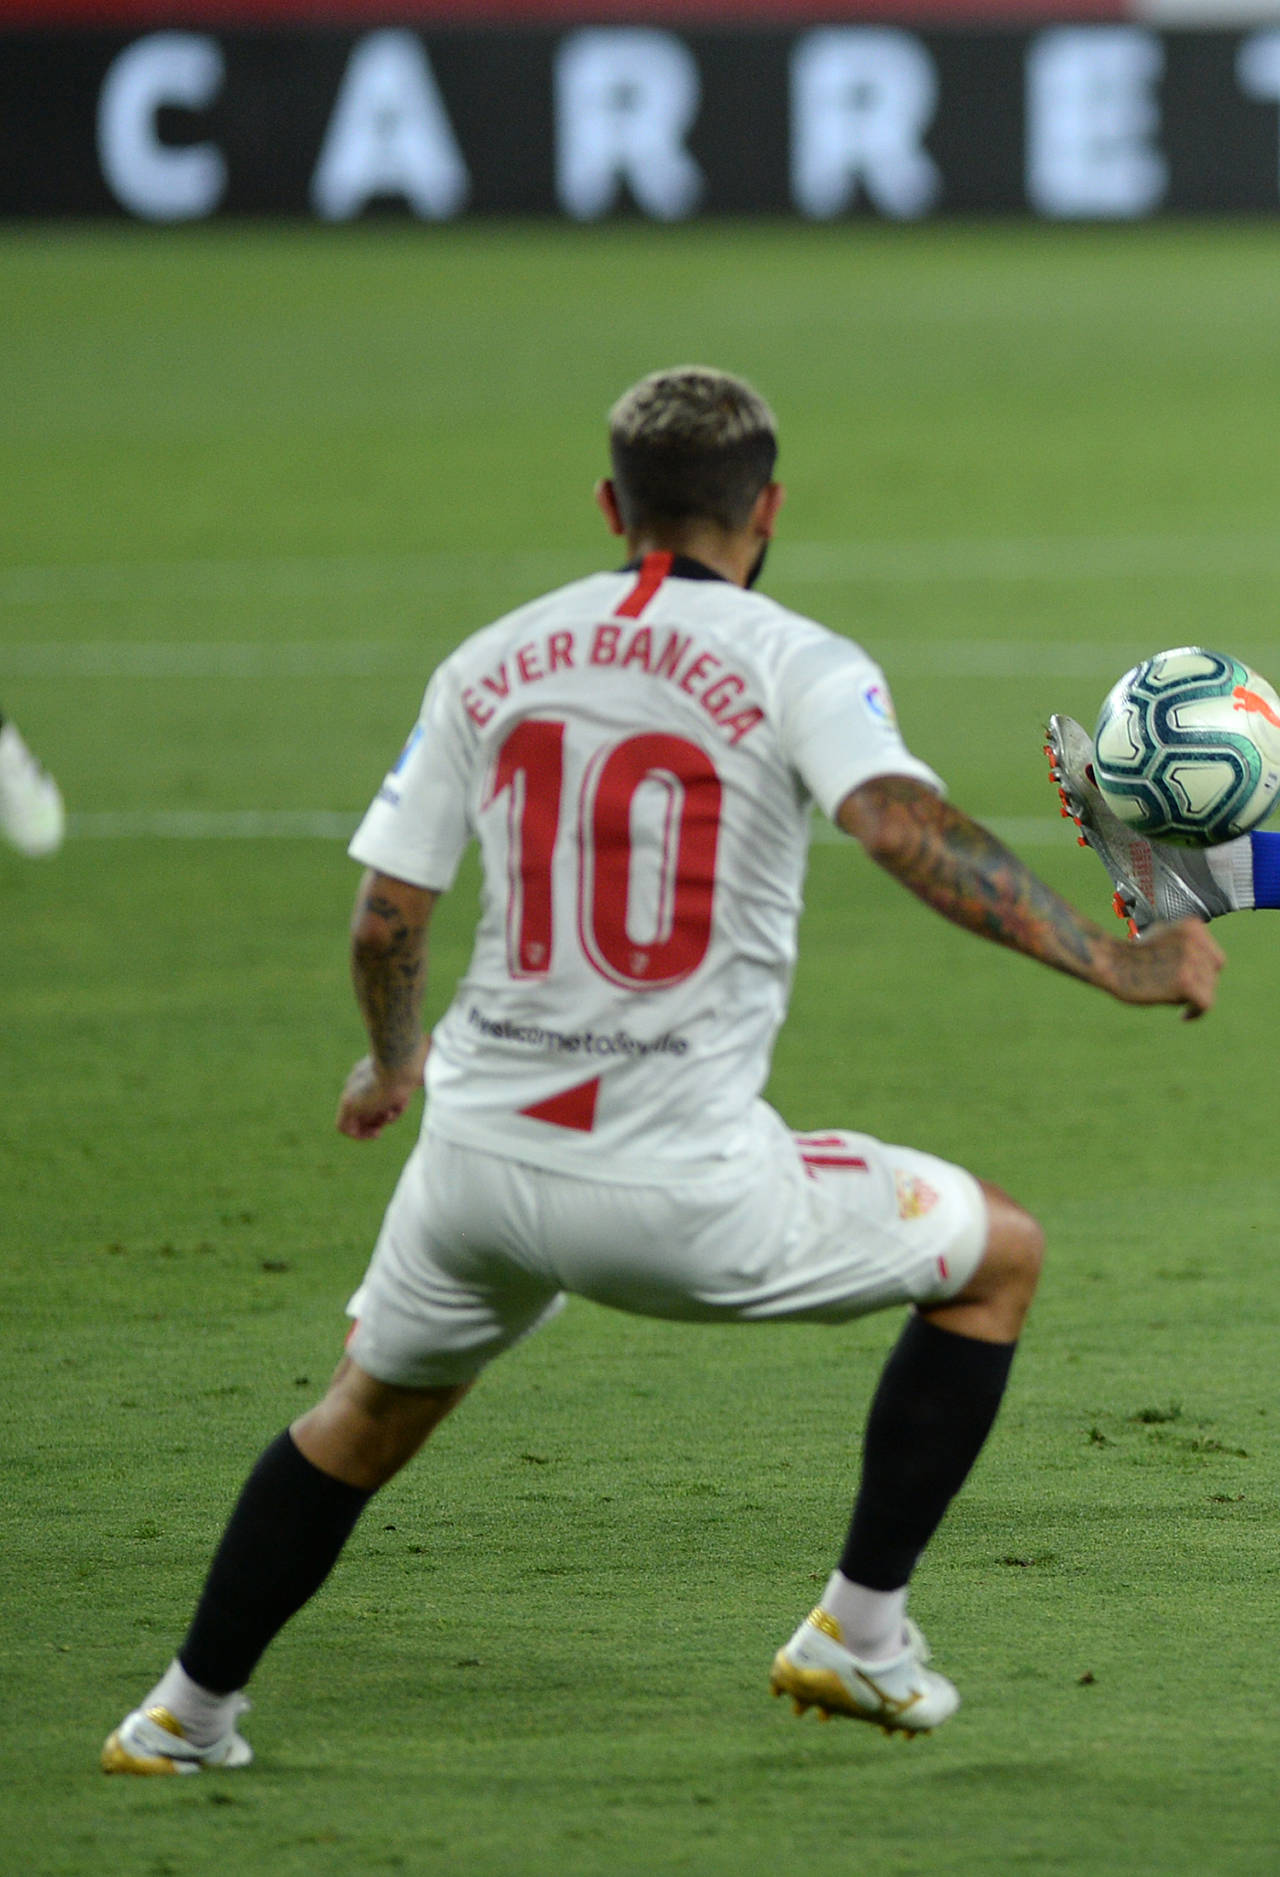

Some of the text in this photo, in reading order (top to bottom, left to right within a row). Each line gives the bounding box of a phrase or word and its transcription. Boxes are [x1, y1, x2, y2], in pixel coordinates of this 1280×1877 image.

[461, 623, 767, 746] EVER BANEGA
[481, 718, 723, 992] 10
